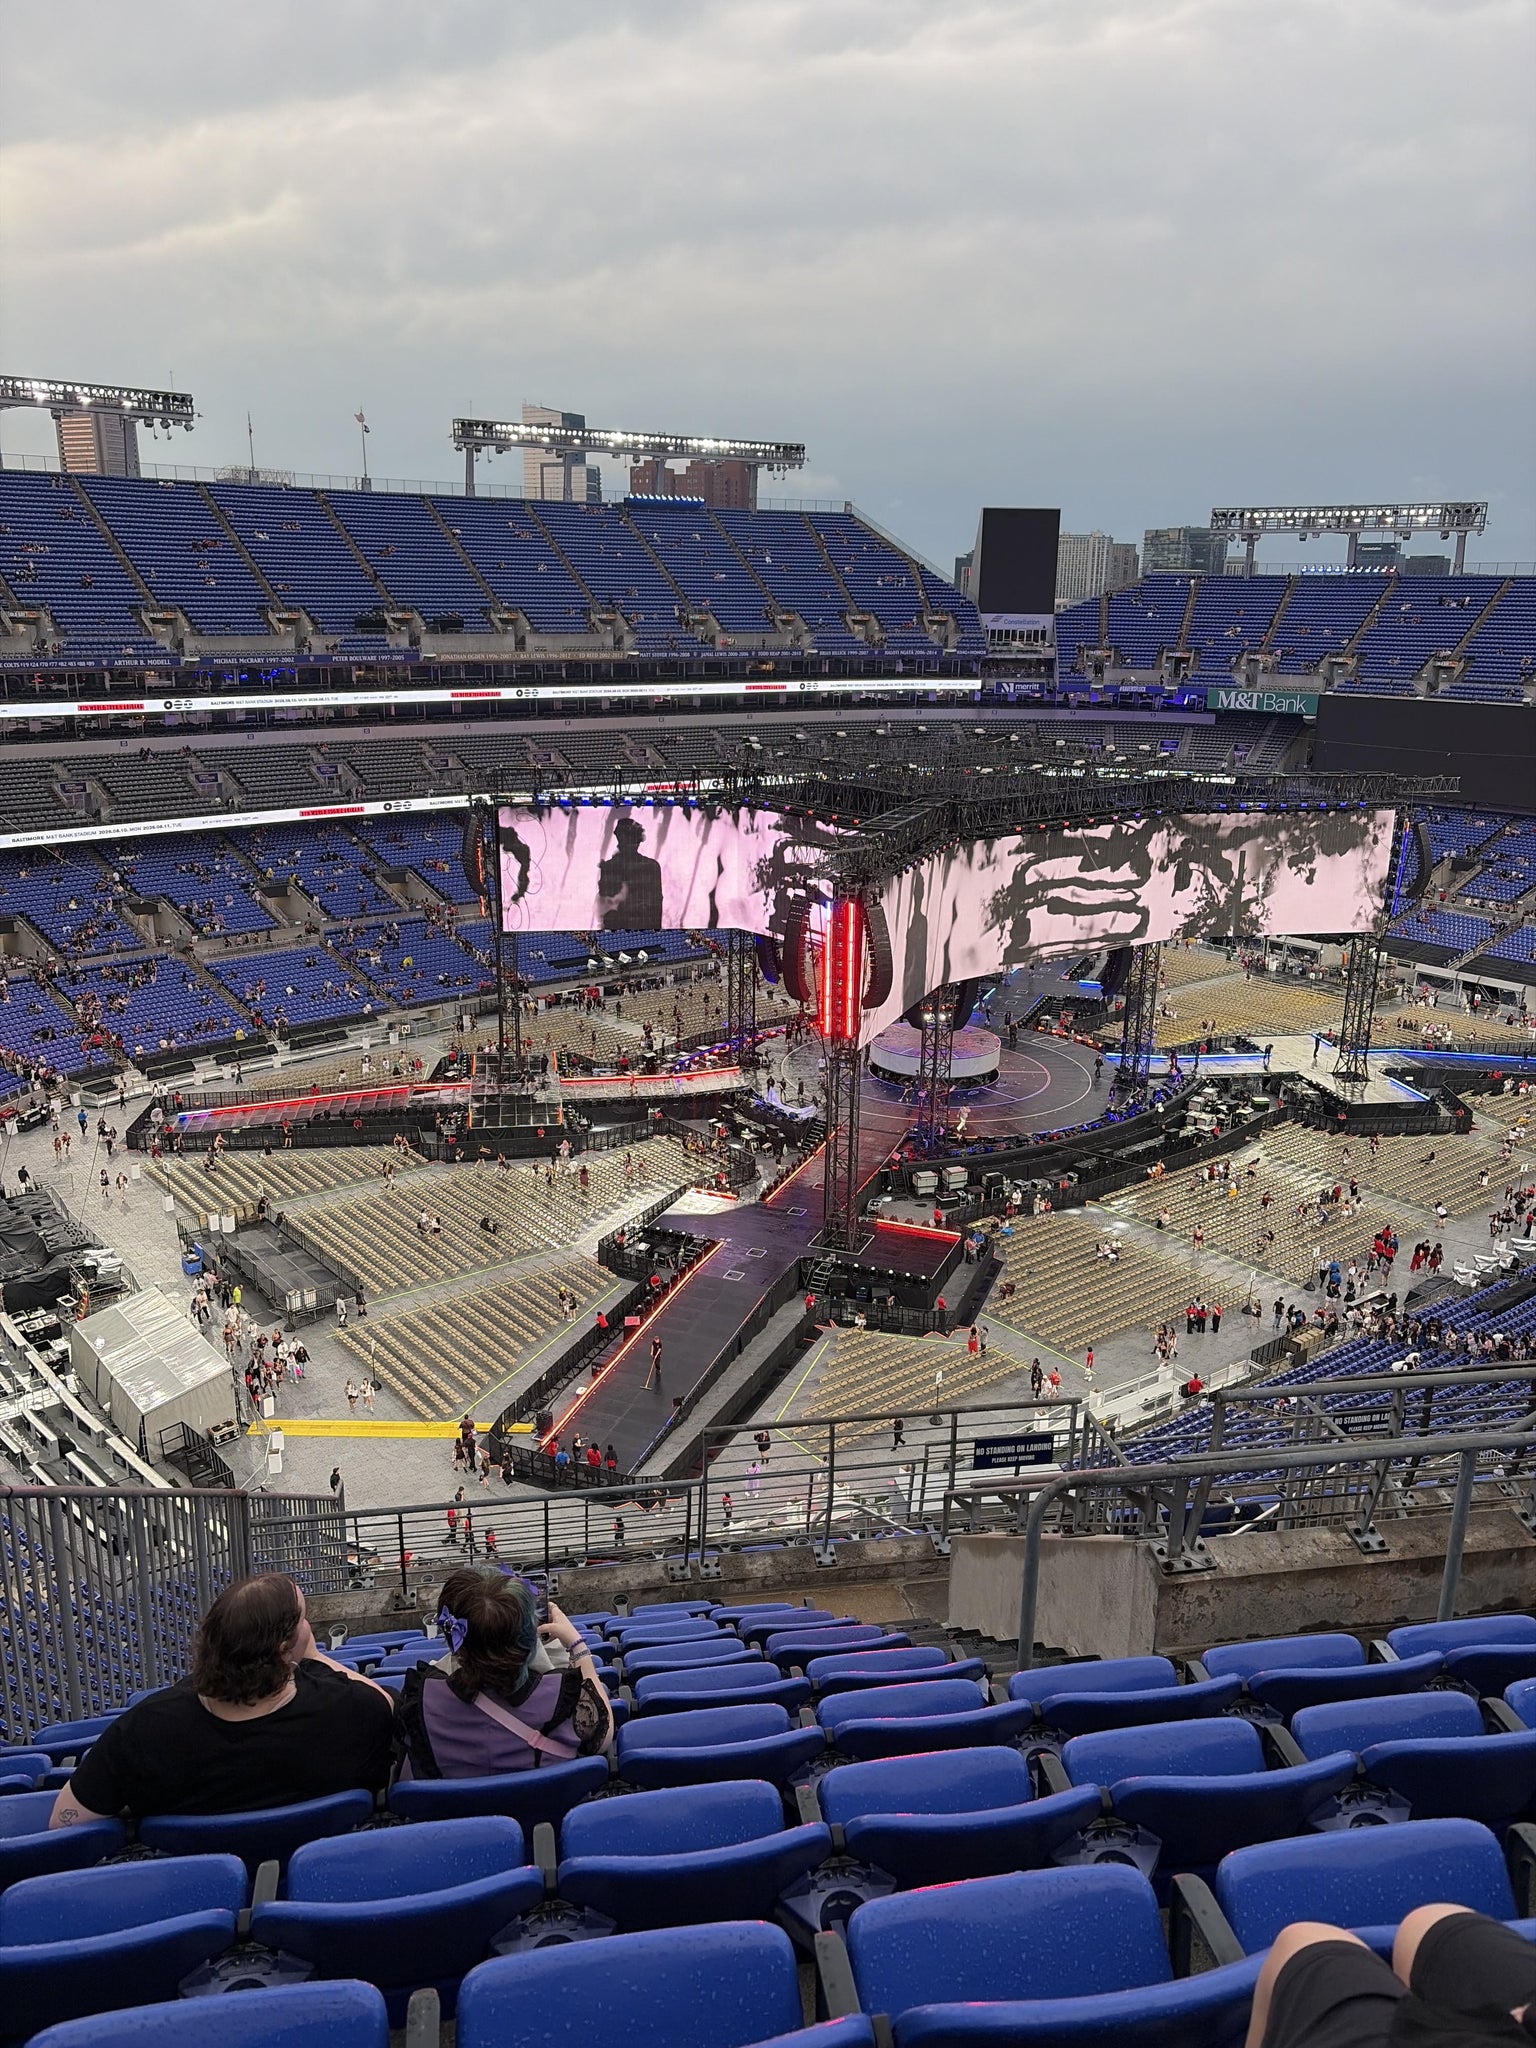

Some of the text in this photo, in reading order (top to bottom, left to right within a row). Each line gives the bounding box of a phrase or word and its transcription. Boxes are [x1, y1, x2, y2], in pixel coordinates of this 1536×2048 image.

[1015, 682, 1040, 690] merritt
[1217, 690, 1307, 713] M&T Bank
[11, 835, 45, 843] BALTIMORE
[1334, 1417, 1343, 1425] NO
[1343, 1414, 1371, 1425] STANDING
[1371, 1413, 1380, 1422] ON
[1348, 1425, 1363, 1433] PLEASE
[975, 1442, 1052, 1456] NO STANDING ON LANDING
[991, 1456, 1007, 1464] PLEASE
[1018, 1454, 1036, 1462] MOVING
